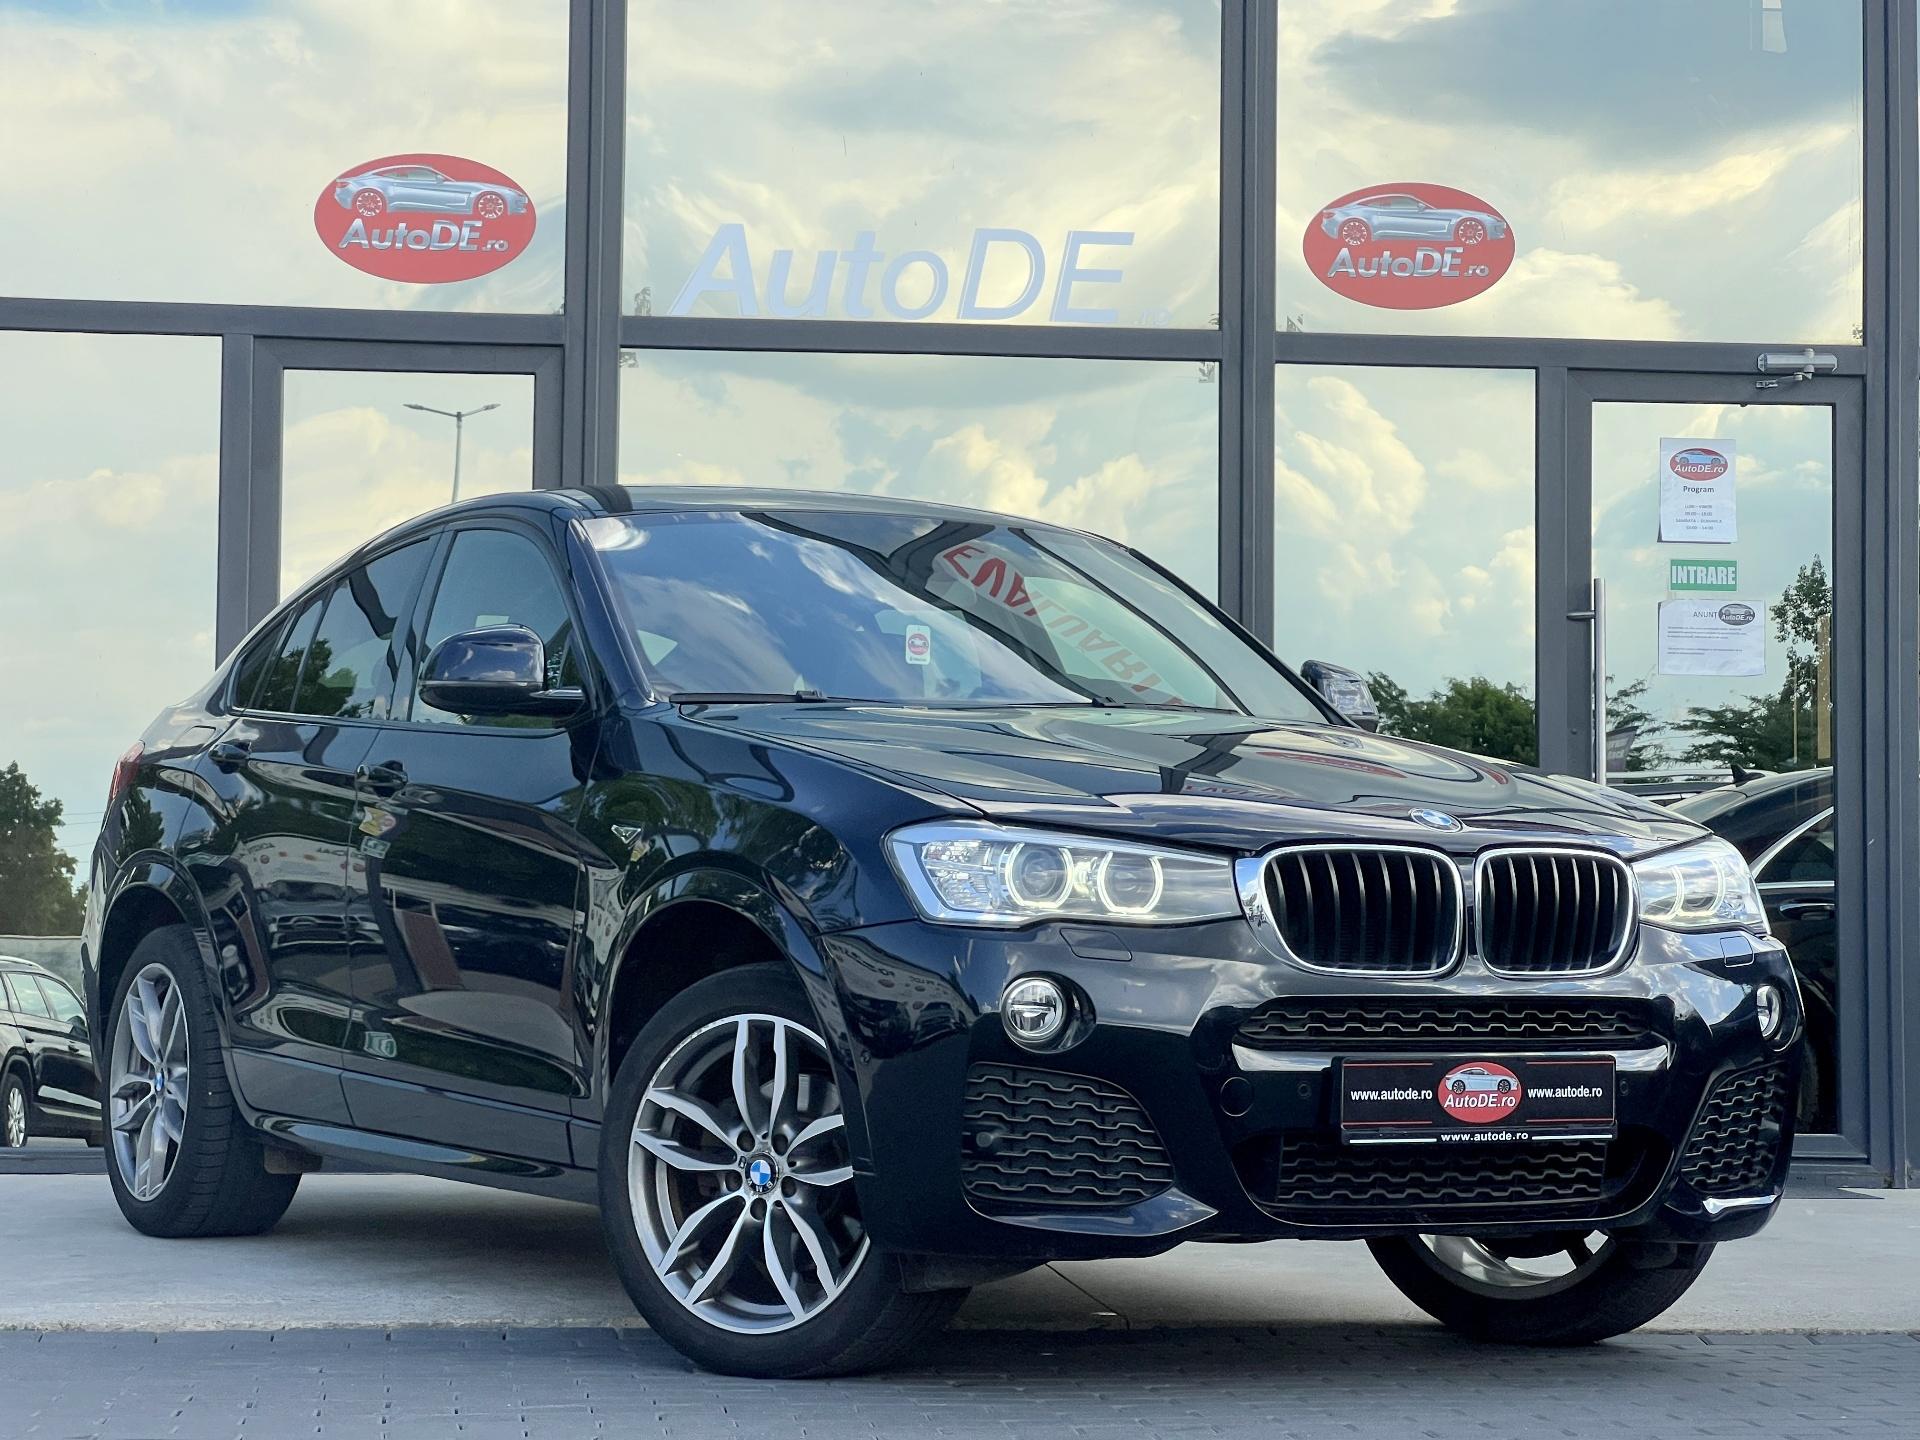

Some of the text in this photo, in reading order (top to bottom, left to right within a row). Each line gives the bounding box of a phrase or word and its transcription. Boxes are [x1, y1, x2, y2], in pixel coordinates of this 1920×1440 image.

[1673, 464, 1724, 473] AutoDE.ro
[1683, 485, 1715, 494] Program
[1671, 565, 1736, 585] INTRARE
[1350, 1088, 1433, 1100] www.autode.ro
[1527, 1085, 1603, 1099] www.autode.ro
[1443, 1093, 1516, 1109] AutoDE.ro
[1440, 1131, 1529, 1142] www.autode.ro
